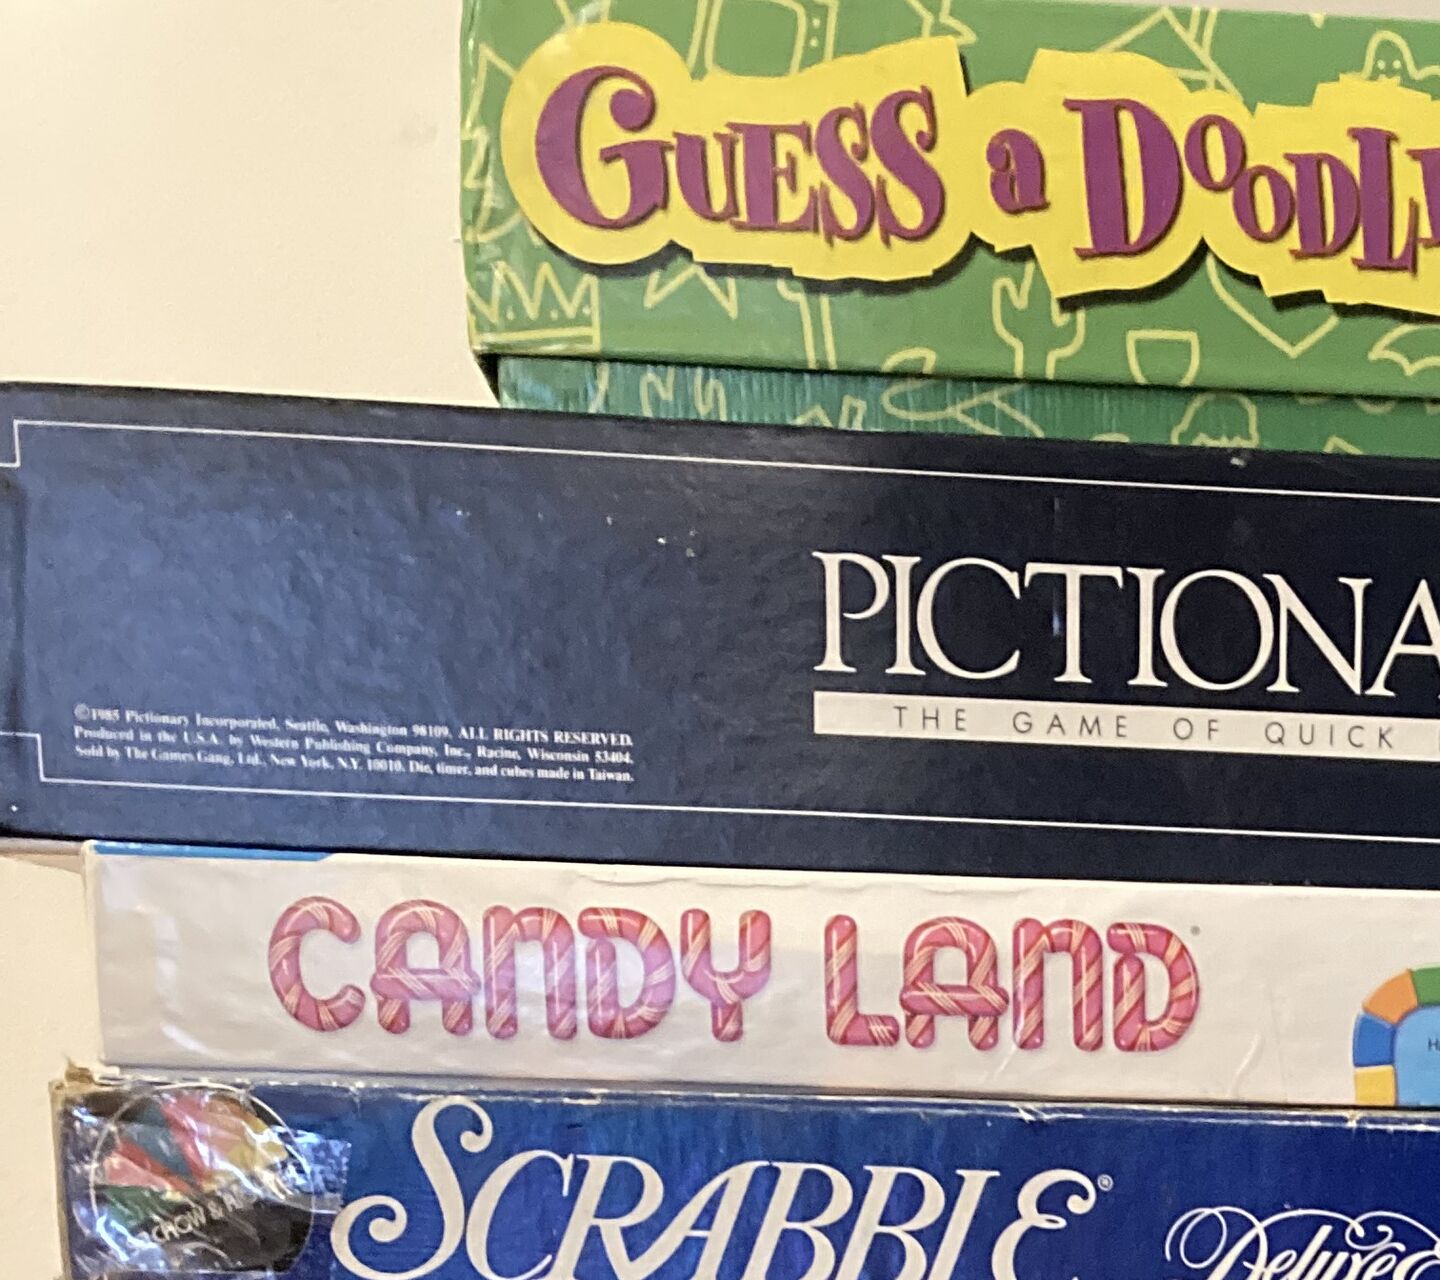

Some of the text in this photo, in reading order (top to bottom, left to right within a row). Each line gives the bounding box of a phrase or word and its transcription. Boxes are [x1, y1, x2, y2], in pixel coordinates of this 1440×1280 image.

[985, 129, 1050, 214] a
[459, 726, 633, 747] ALL RIGHTS RESERVED.
[894, 705, 969, 732] THE
[1012, 710, 1130, 741] GAME
[1172, 717, 1222, 742] OF
[1265, 720, 1396, 751] QUICK
[268, 895, 1202, 1053] CANDY LAND
